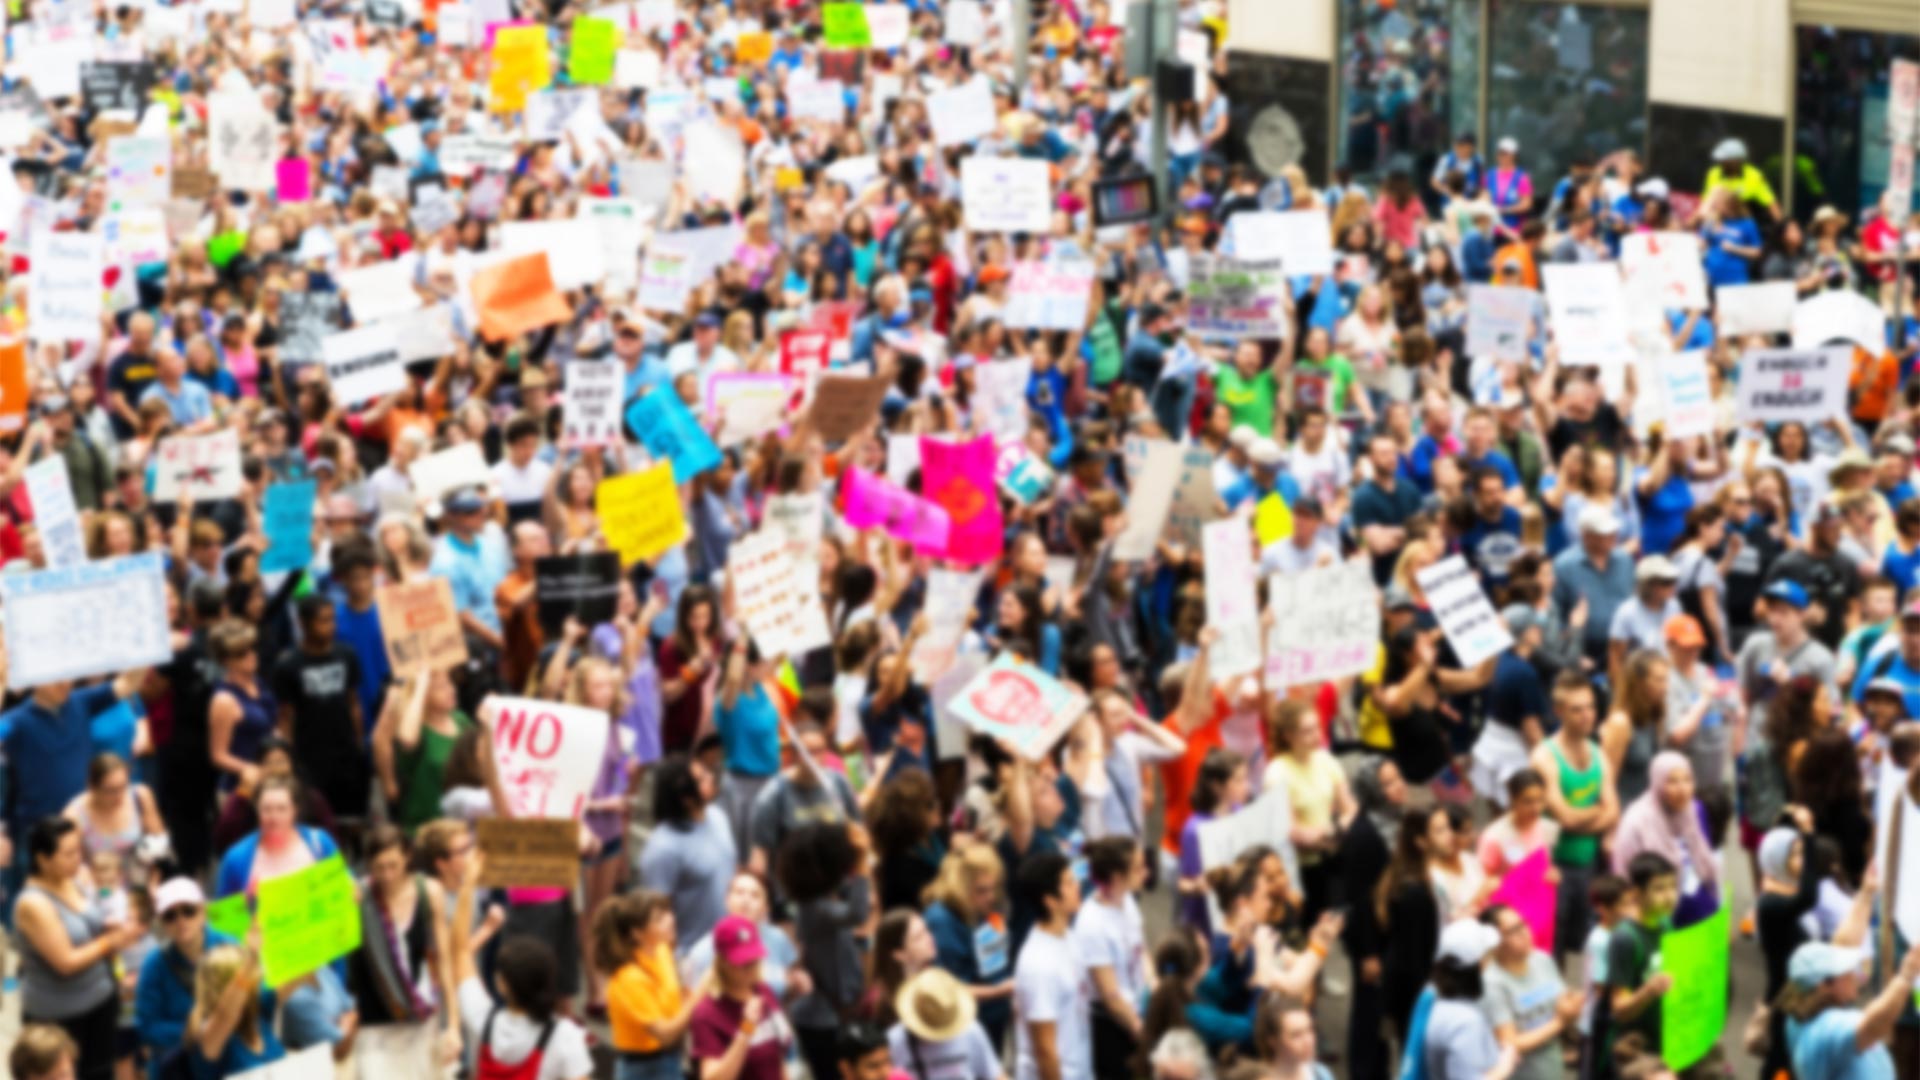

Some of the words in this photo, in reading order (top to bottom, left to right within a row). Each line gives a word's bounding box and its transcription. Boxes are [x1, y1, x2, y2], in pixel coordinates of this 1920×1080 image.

[1756, 354, 1826, 372] ENOUGH
[1750, 389, 1822, 408] ENOUGH
[494, 709, 562, 760] NO
